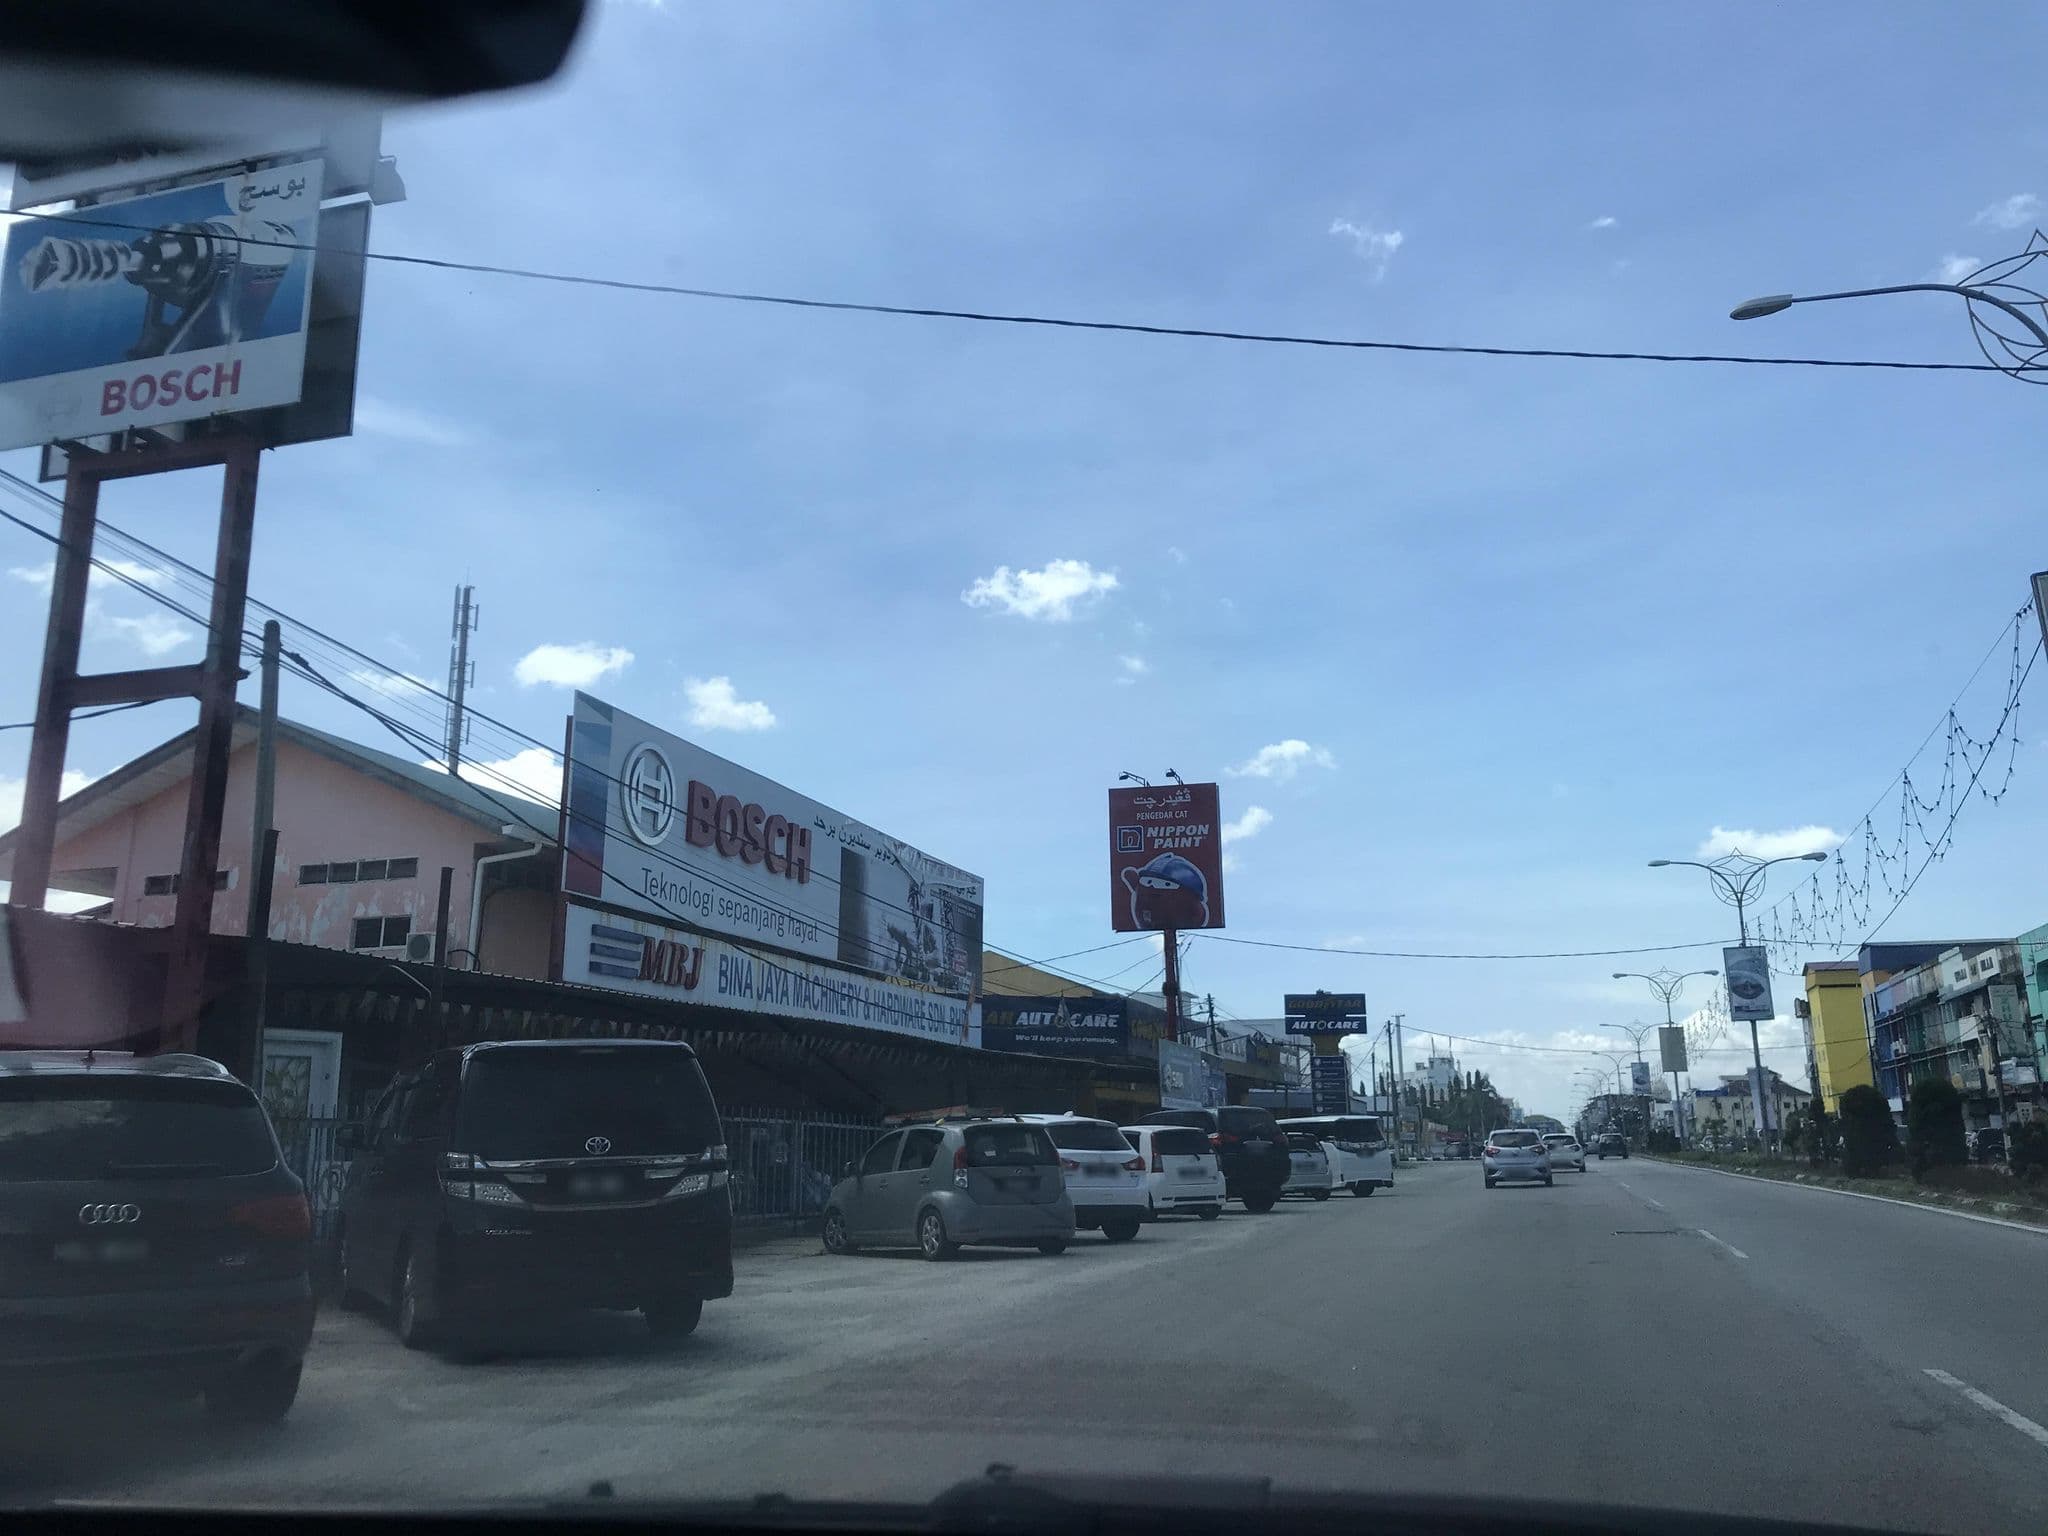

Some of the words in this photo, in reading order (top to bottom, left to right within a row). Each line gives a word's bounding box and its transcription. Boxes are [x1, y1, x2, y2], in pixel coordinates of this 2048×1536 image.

[100, 359, 242, 417] BOSCH
[1136, 812, 1173, 820] PENGEDAR
[1175, 810, 1188, 818] CAT
[685, 779, 812, 884] BOSCH
[1146, 824, 1210, 837] NIPPON
[1153, 836, 1203, 849] PAINT
[641, 867, 714, 917] Teknologi
[718, 897, 785, 937] sepanjang
[788, 911, 818, 943] hayat
[718, 953, 754, 999] BINA
[756, 962, 790, 1006] JAYA
[792, 969, 862, 1019] MACHINERY
[864, 986, 871, 1020] &
[873, 990, 926, 1032] HARDWARE
[1292, 1020, 1360, 1030] AUTOCARE
[1039, 1035, 1062, 1043] keep
